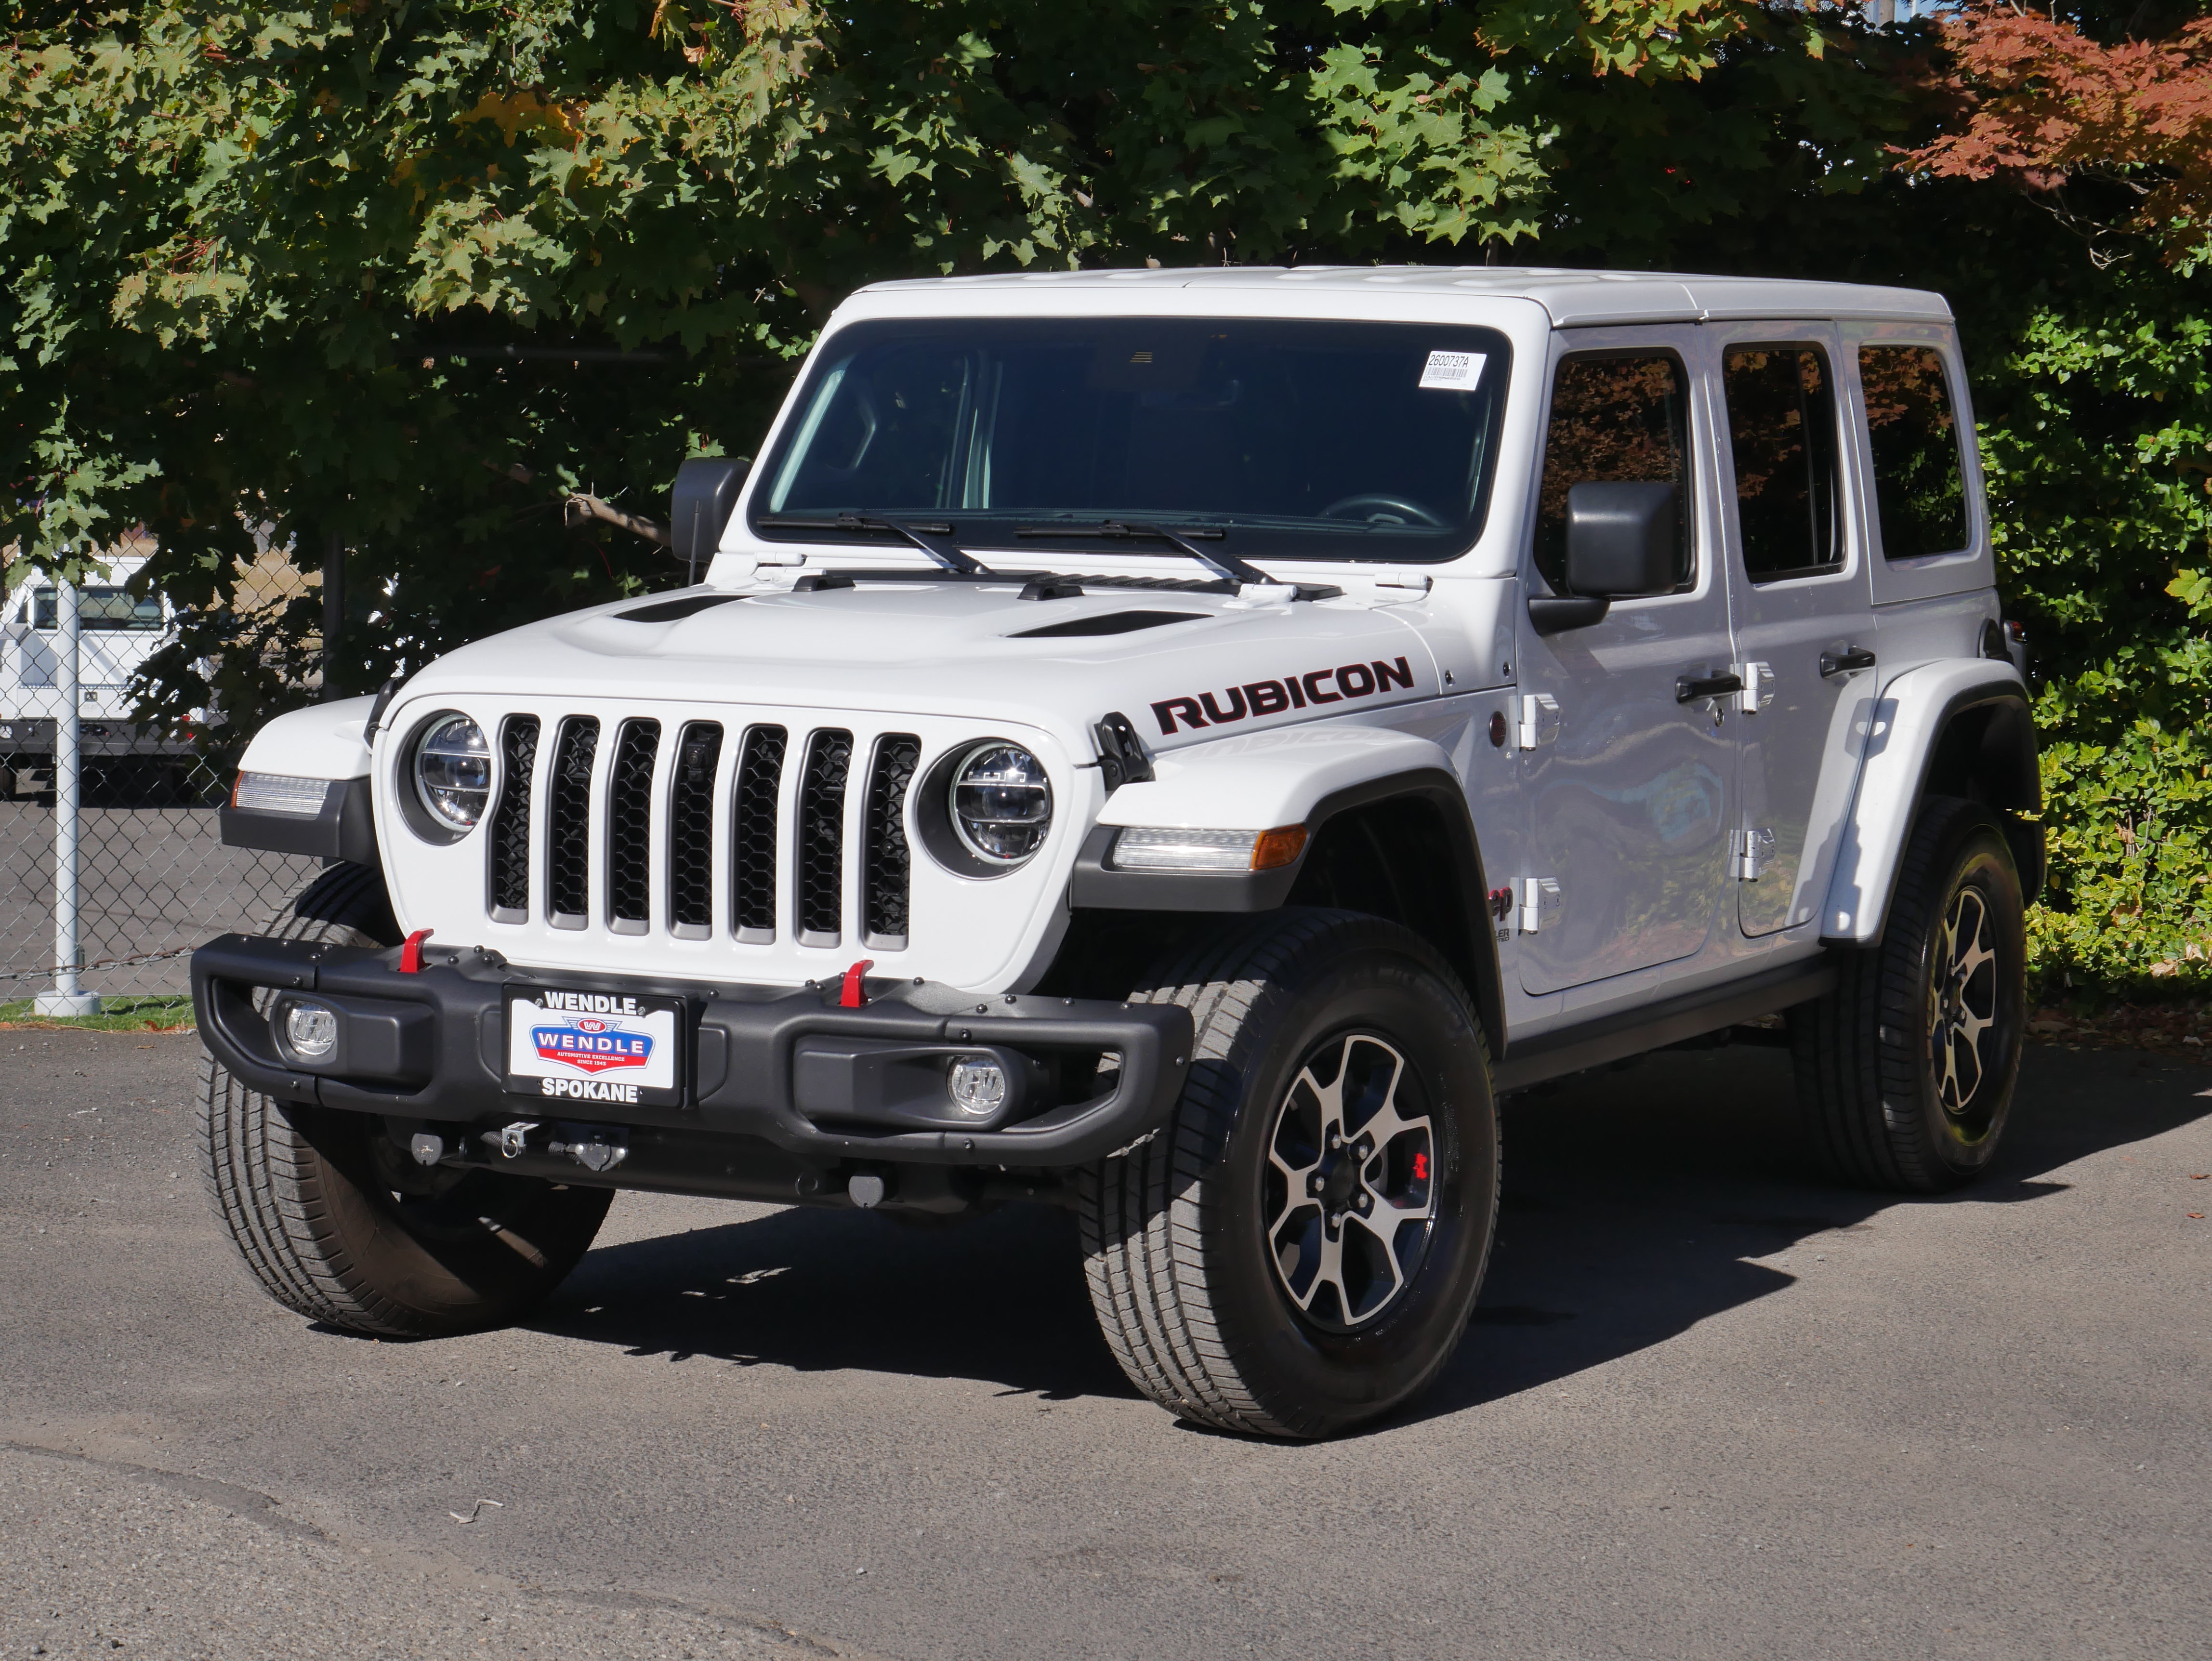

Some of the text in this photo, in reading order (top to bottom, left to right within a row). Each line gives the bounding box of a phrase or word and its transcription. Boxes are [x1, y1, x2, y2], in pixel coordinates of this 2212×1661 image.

[1429, 355, 1469, 368] 2600737A
[1150, 656, 1414, 735] RUBICON
[544, 991, 636, 1015] WENDLE
[538, 1033, 643, 1054] WENDLE
[542, 1078, 638, 1103] SPOKANE
